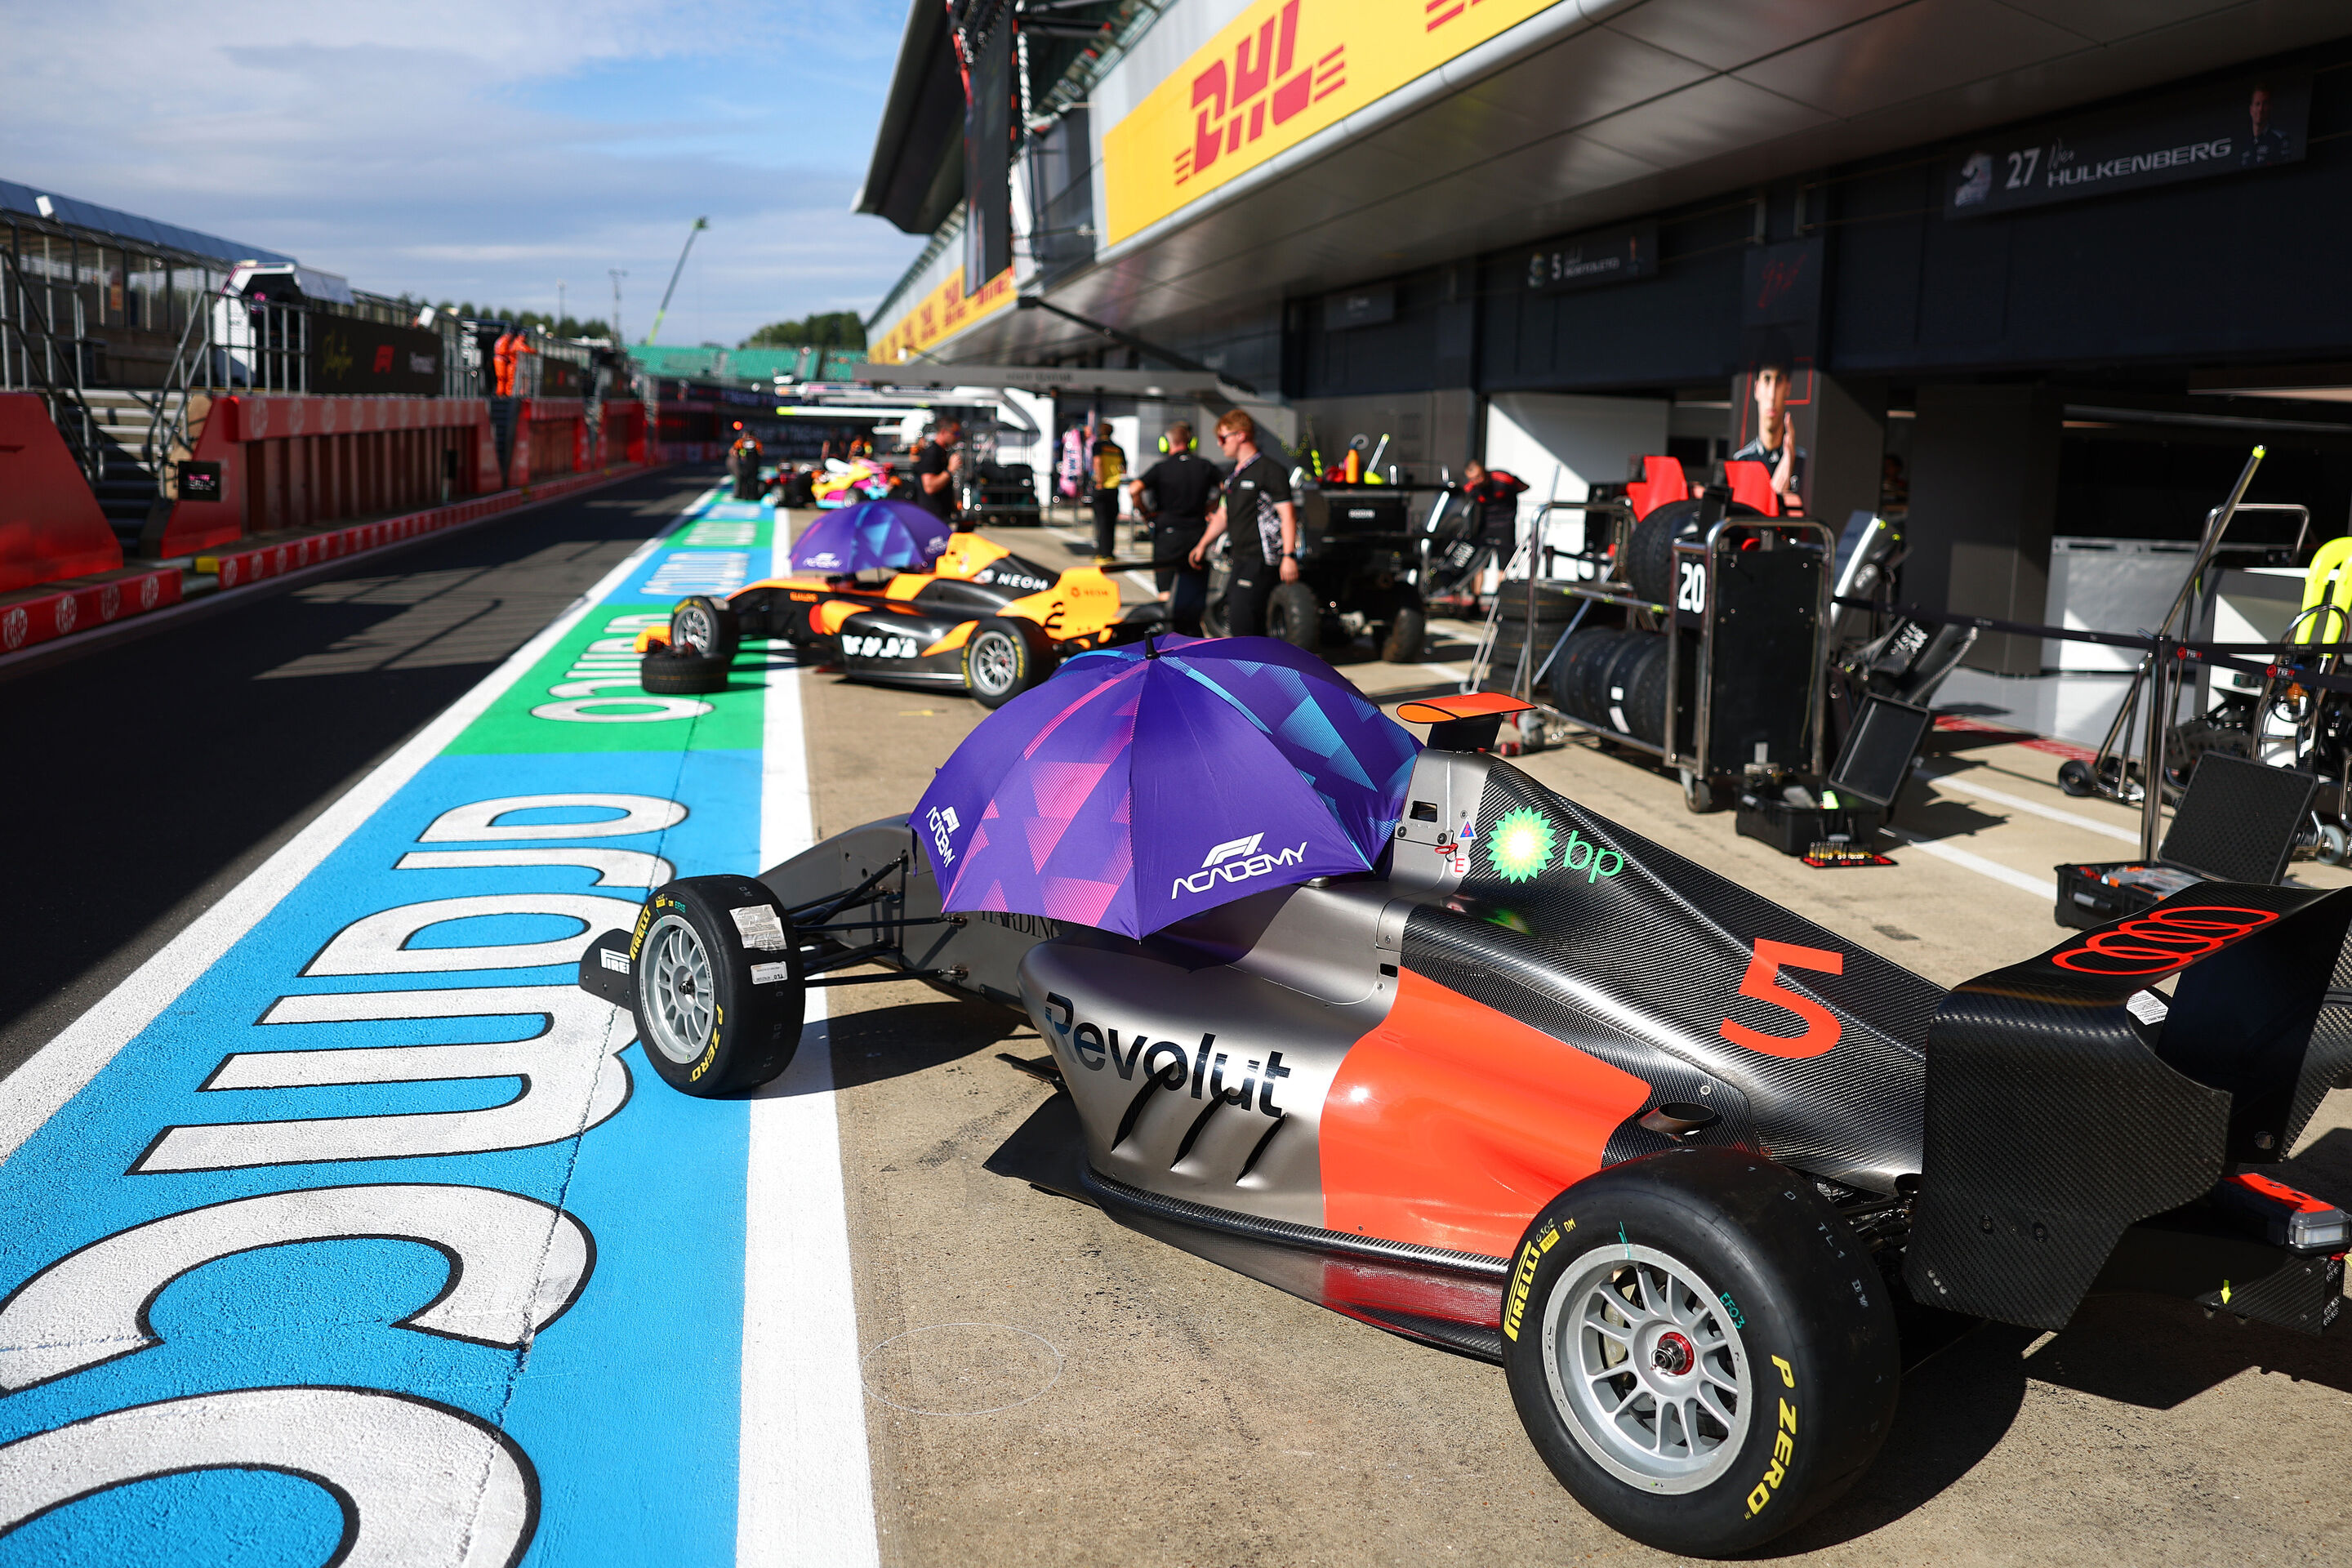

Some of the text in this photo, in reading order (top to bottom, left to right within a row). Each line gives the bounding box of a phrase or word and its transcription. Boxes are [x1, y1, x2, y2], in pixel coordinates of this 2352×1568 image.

[1189, 0, 1313, 175] DHL
[2005, 148, 2041, 189] 27
[2047, 137, 2233, 188] HULKENBERG
[1552, 252, 1561, 281] 5
[996, 572, 1049, 590] NEOM
[1677, 562, 1706, 613] 20
[925, 806, 956, 868] ACADEMY
[1563, 830, 1624, 883] bp
[1171, 841, 1307, 900] ACADEMY
[1454, 858, 1465, 873] E
[629, 904, 652, 961] PIRELLI
[1719, 938, 1844, 1059] 5
[692, 1004, 724, 1081] P ZERO
[1045, 991, 1291, 1118] Revolut
[1563, 1218, 1576, 1232] DM
[1503, 1241, 1542, 1343] PIRELLI
[1719, 1292, 1745, 1330] EF03
[1747, 1354, 1797, 1515] P ZERO
